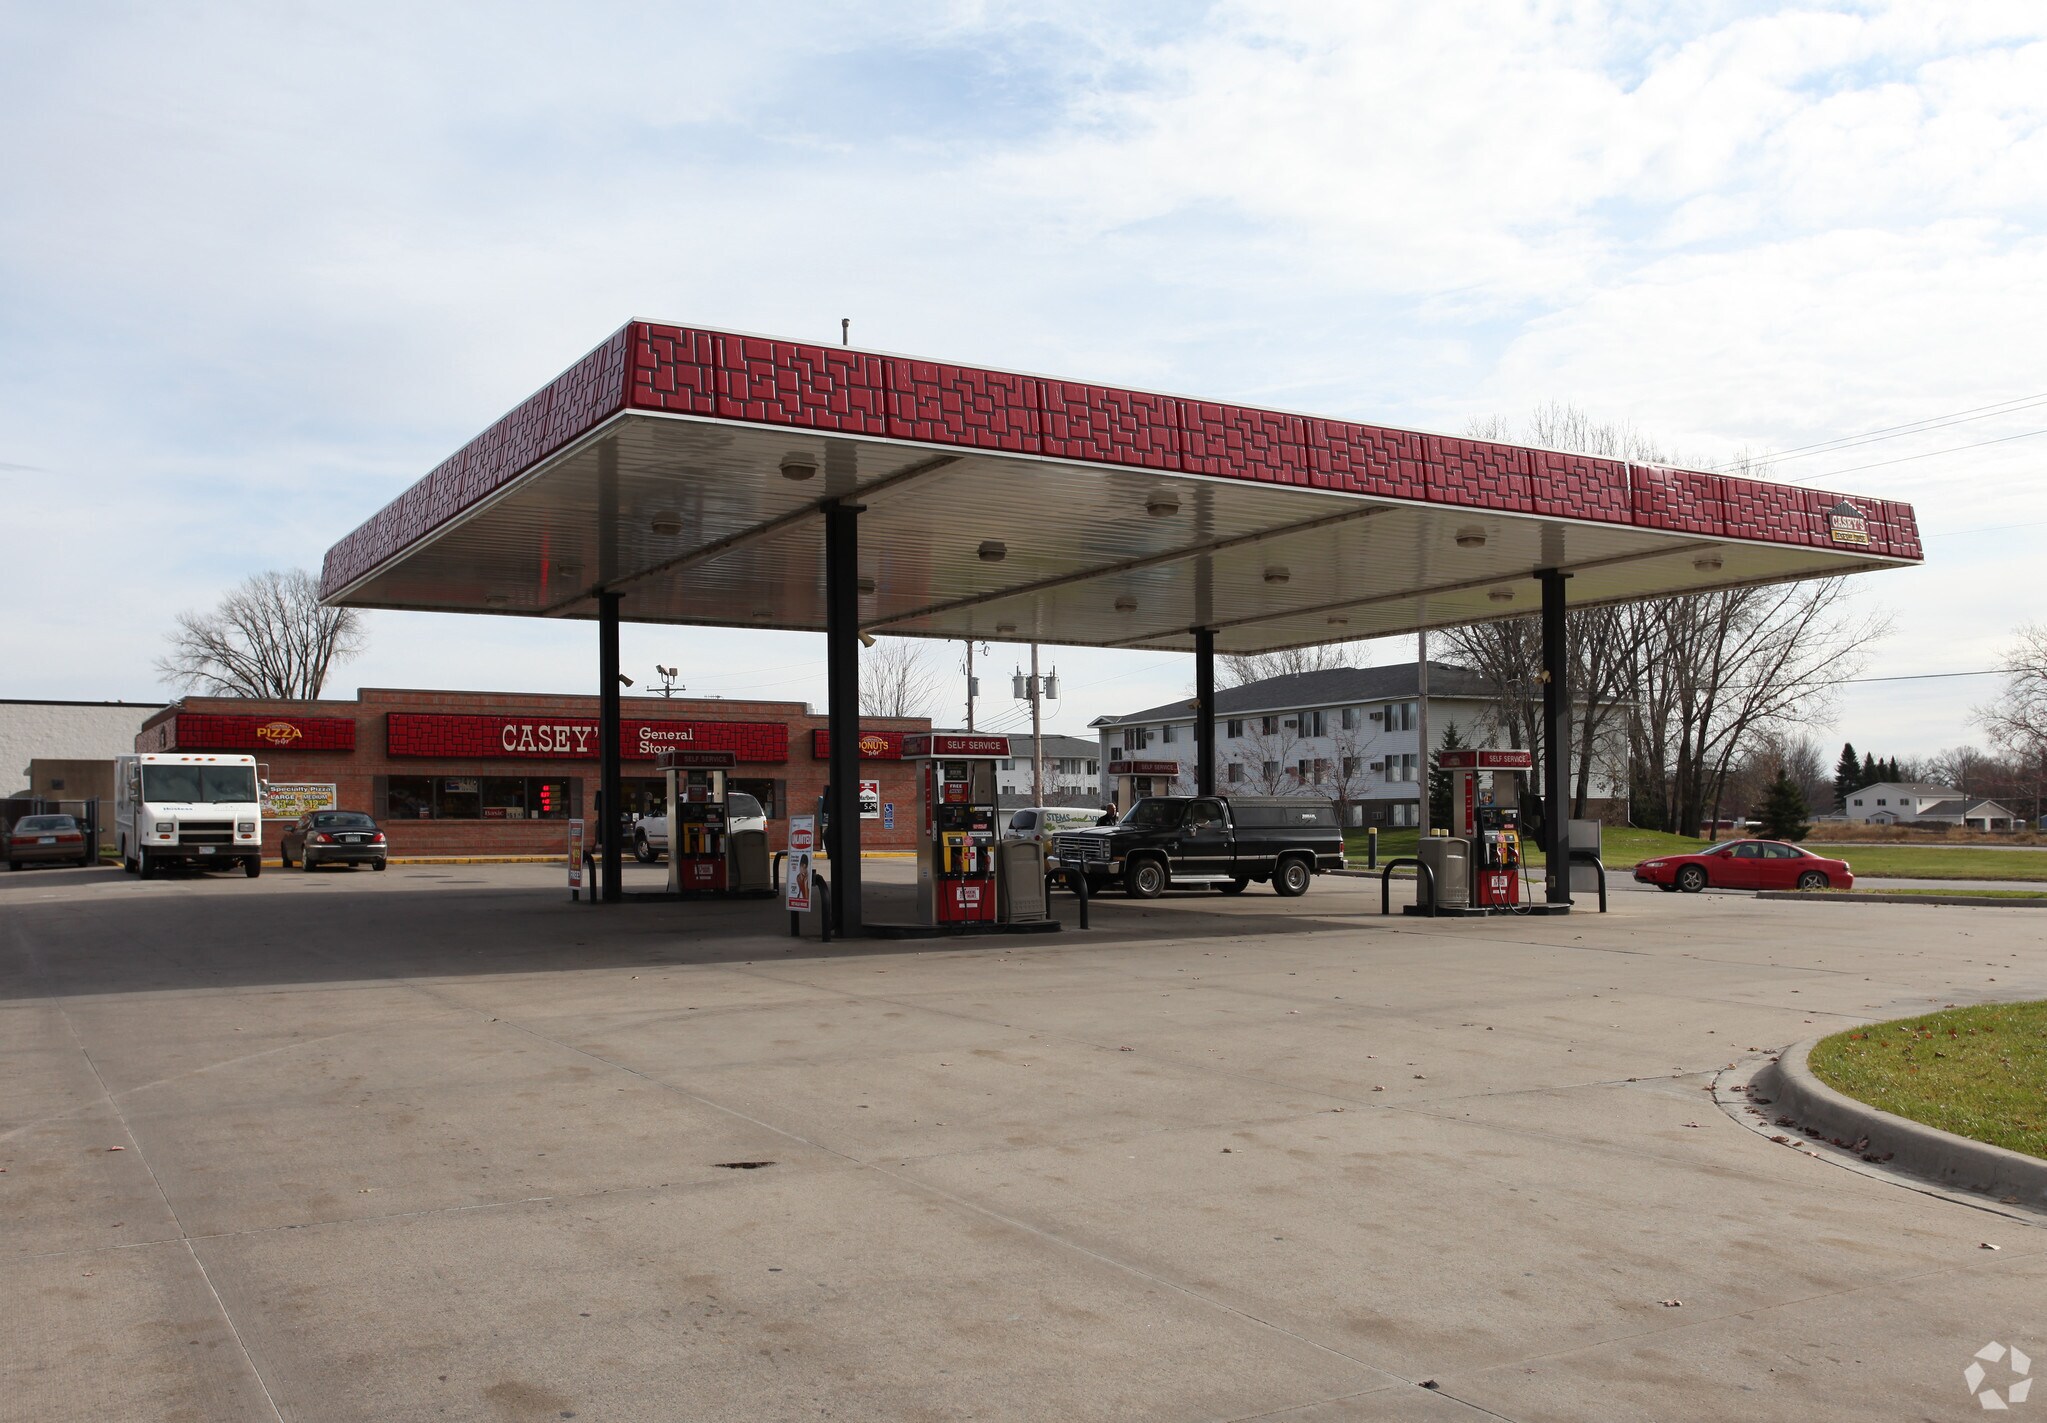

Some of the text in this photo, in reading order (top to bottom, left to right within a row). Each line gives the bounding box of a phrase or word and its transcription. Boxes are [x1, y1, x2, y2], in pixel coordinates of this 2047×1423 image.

[1832, 515, 1866, 531] CASEY'S
[257, 727, 303, 738] PIZZA
[502, 724, 599, 752] CASEY'
[639, 727, 694, 741] General
[639, 741, 676, 754] Store
[947, 740, 1001, 750] SELF SERVICE
[1489, 755, 1526, 763] SELF SERVICE
[1046, 812, 1071, 823] STEMS
